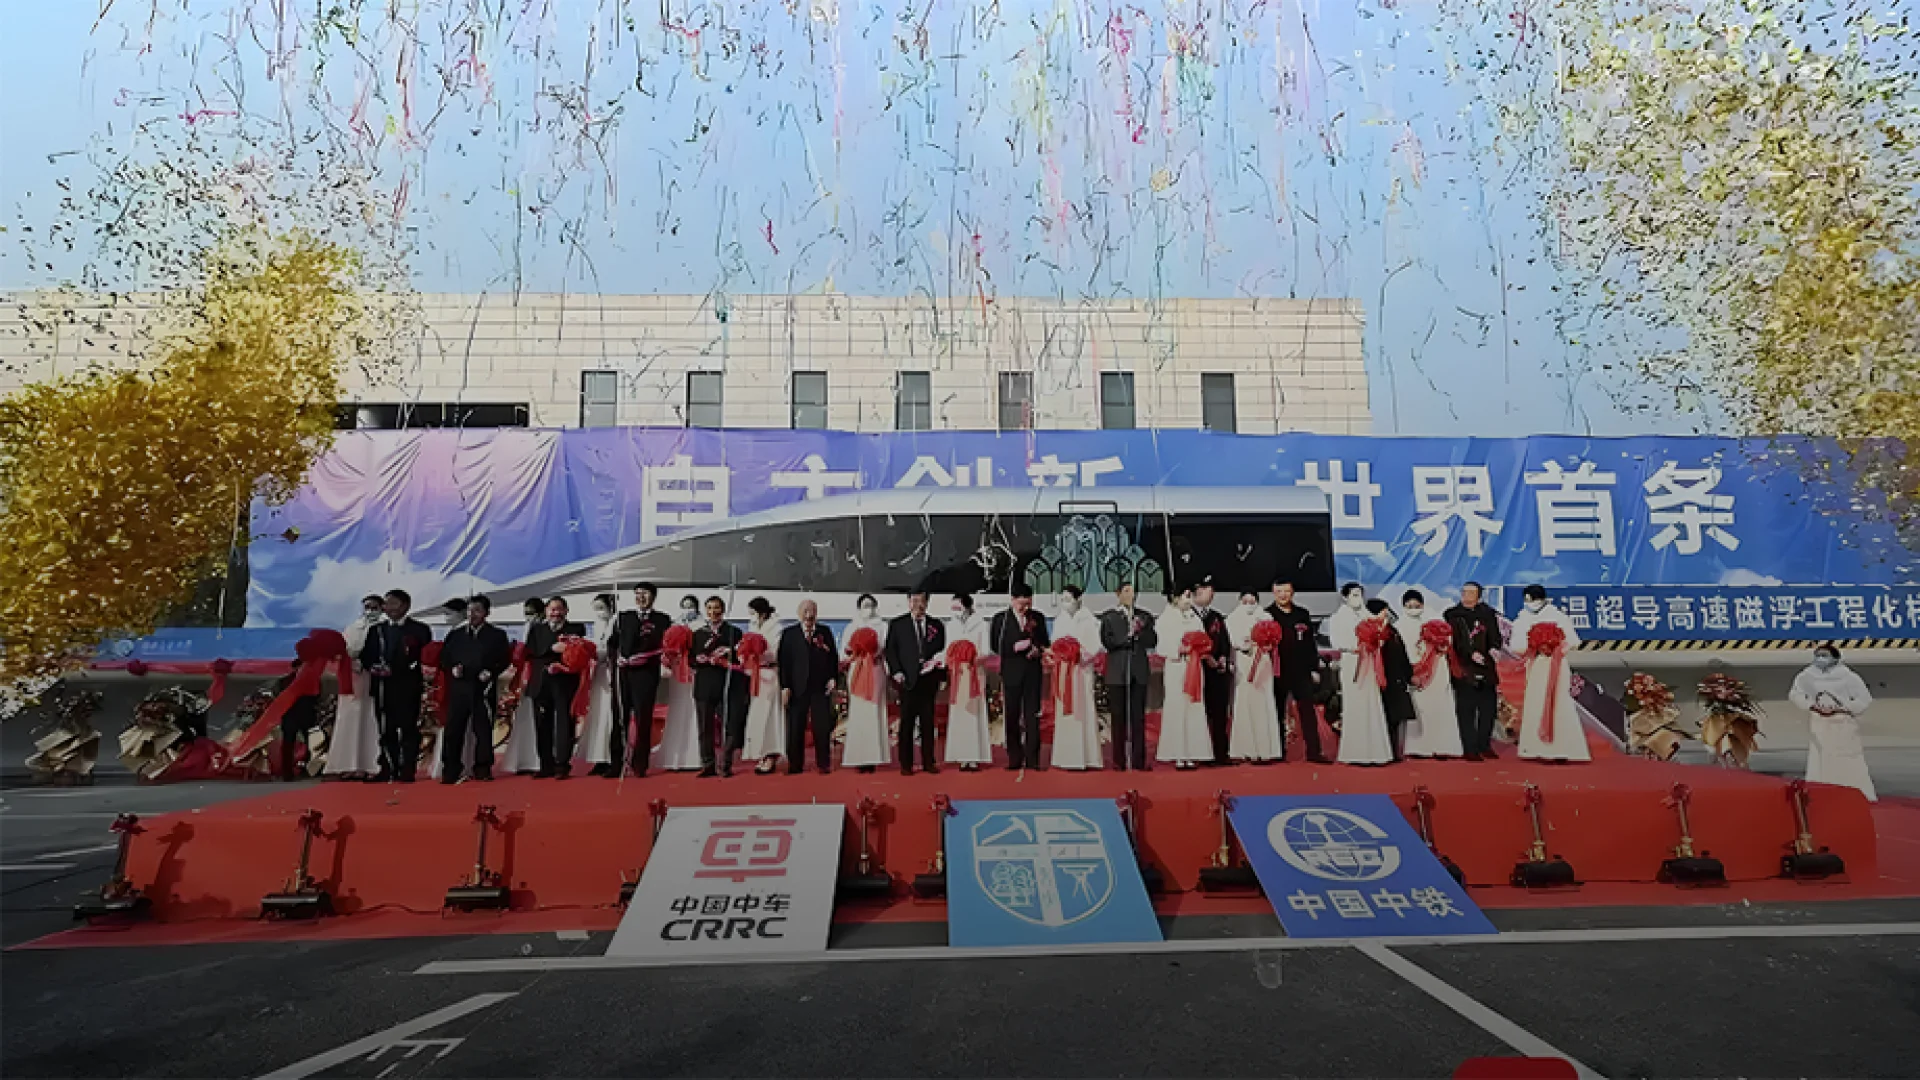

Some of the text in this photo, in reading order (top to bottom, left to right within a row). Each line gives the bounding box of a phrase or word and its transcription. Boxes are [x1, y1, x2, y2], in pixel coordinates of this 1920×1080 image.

[1296, 458, 1742, 558] 世界首条
[1545, 594, 1920, 631] 温超导高速磁浮工程化
[670, 893, 792, 916] 中国中车
[1288, 886, 1465, 920] 中国中铁
[660, 916, 788, 942] CRRC
